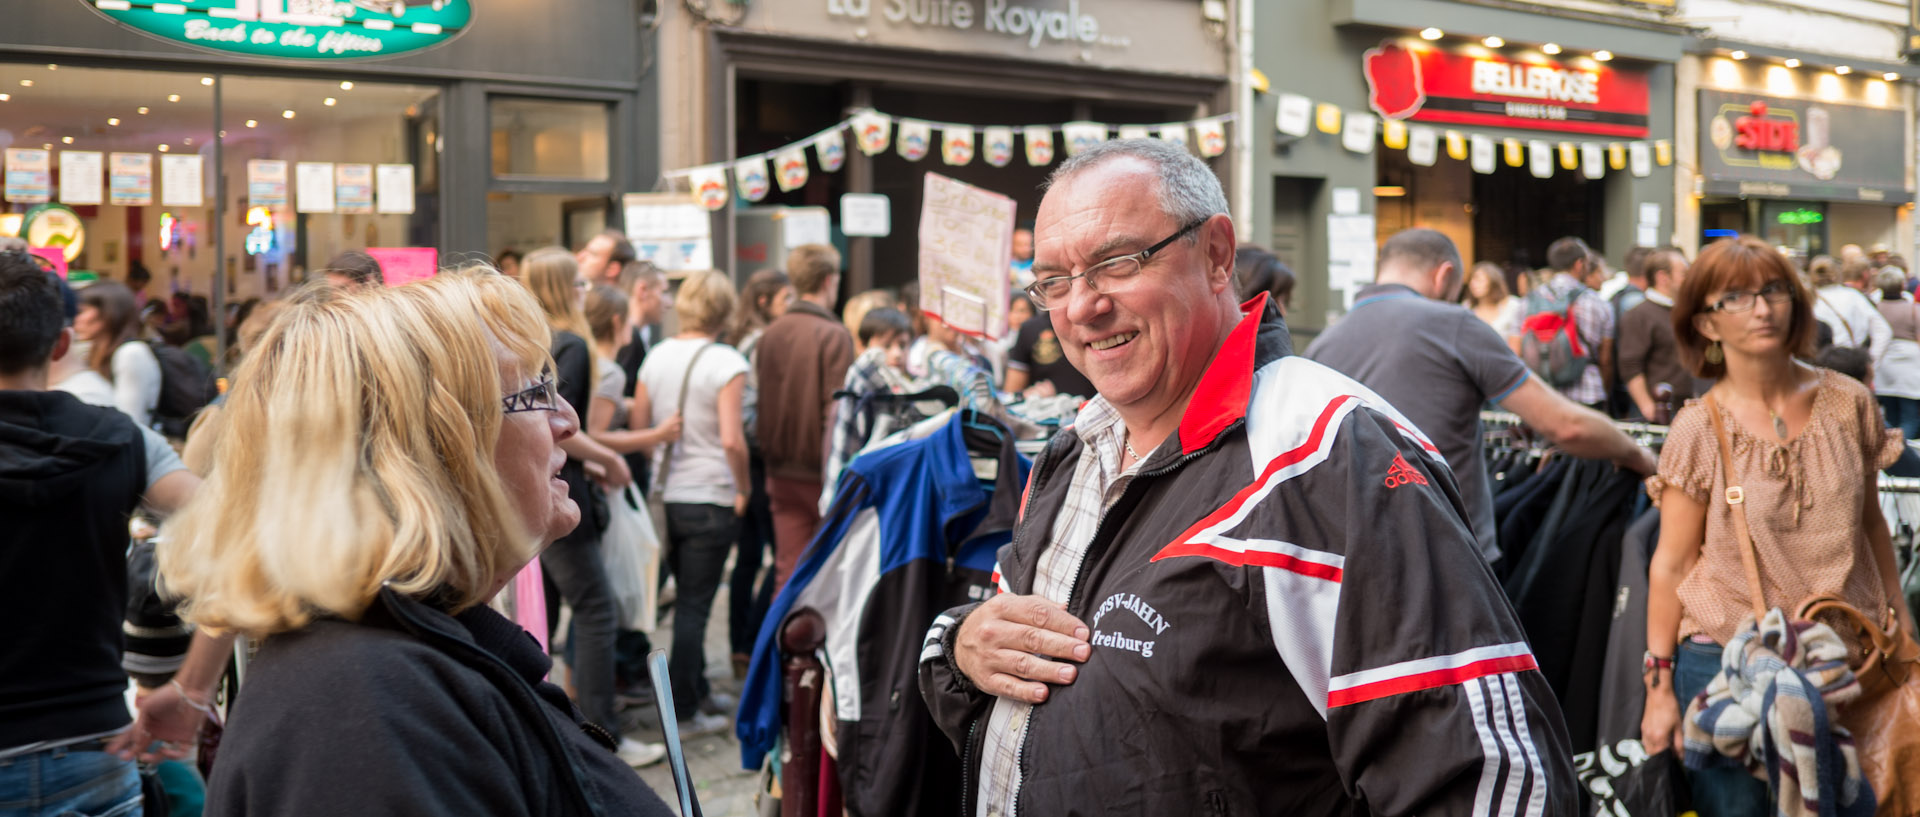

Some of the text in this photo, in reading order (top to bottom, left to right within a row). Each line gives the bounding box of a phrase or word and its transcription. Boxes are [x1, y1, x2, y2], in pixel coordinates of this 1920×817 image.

[882, 0, 974, 28] Suite
[184, 19, 246, 42] Back
[251, 28, 276, 44] to
[279, 27, 316, 47] the
[1472, 60, 1599, 103] BELLEROSE
